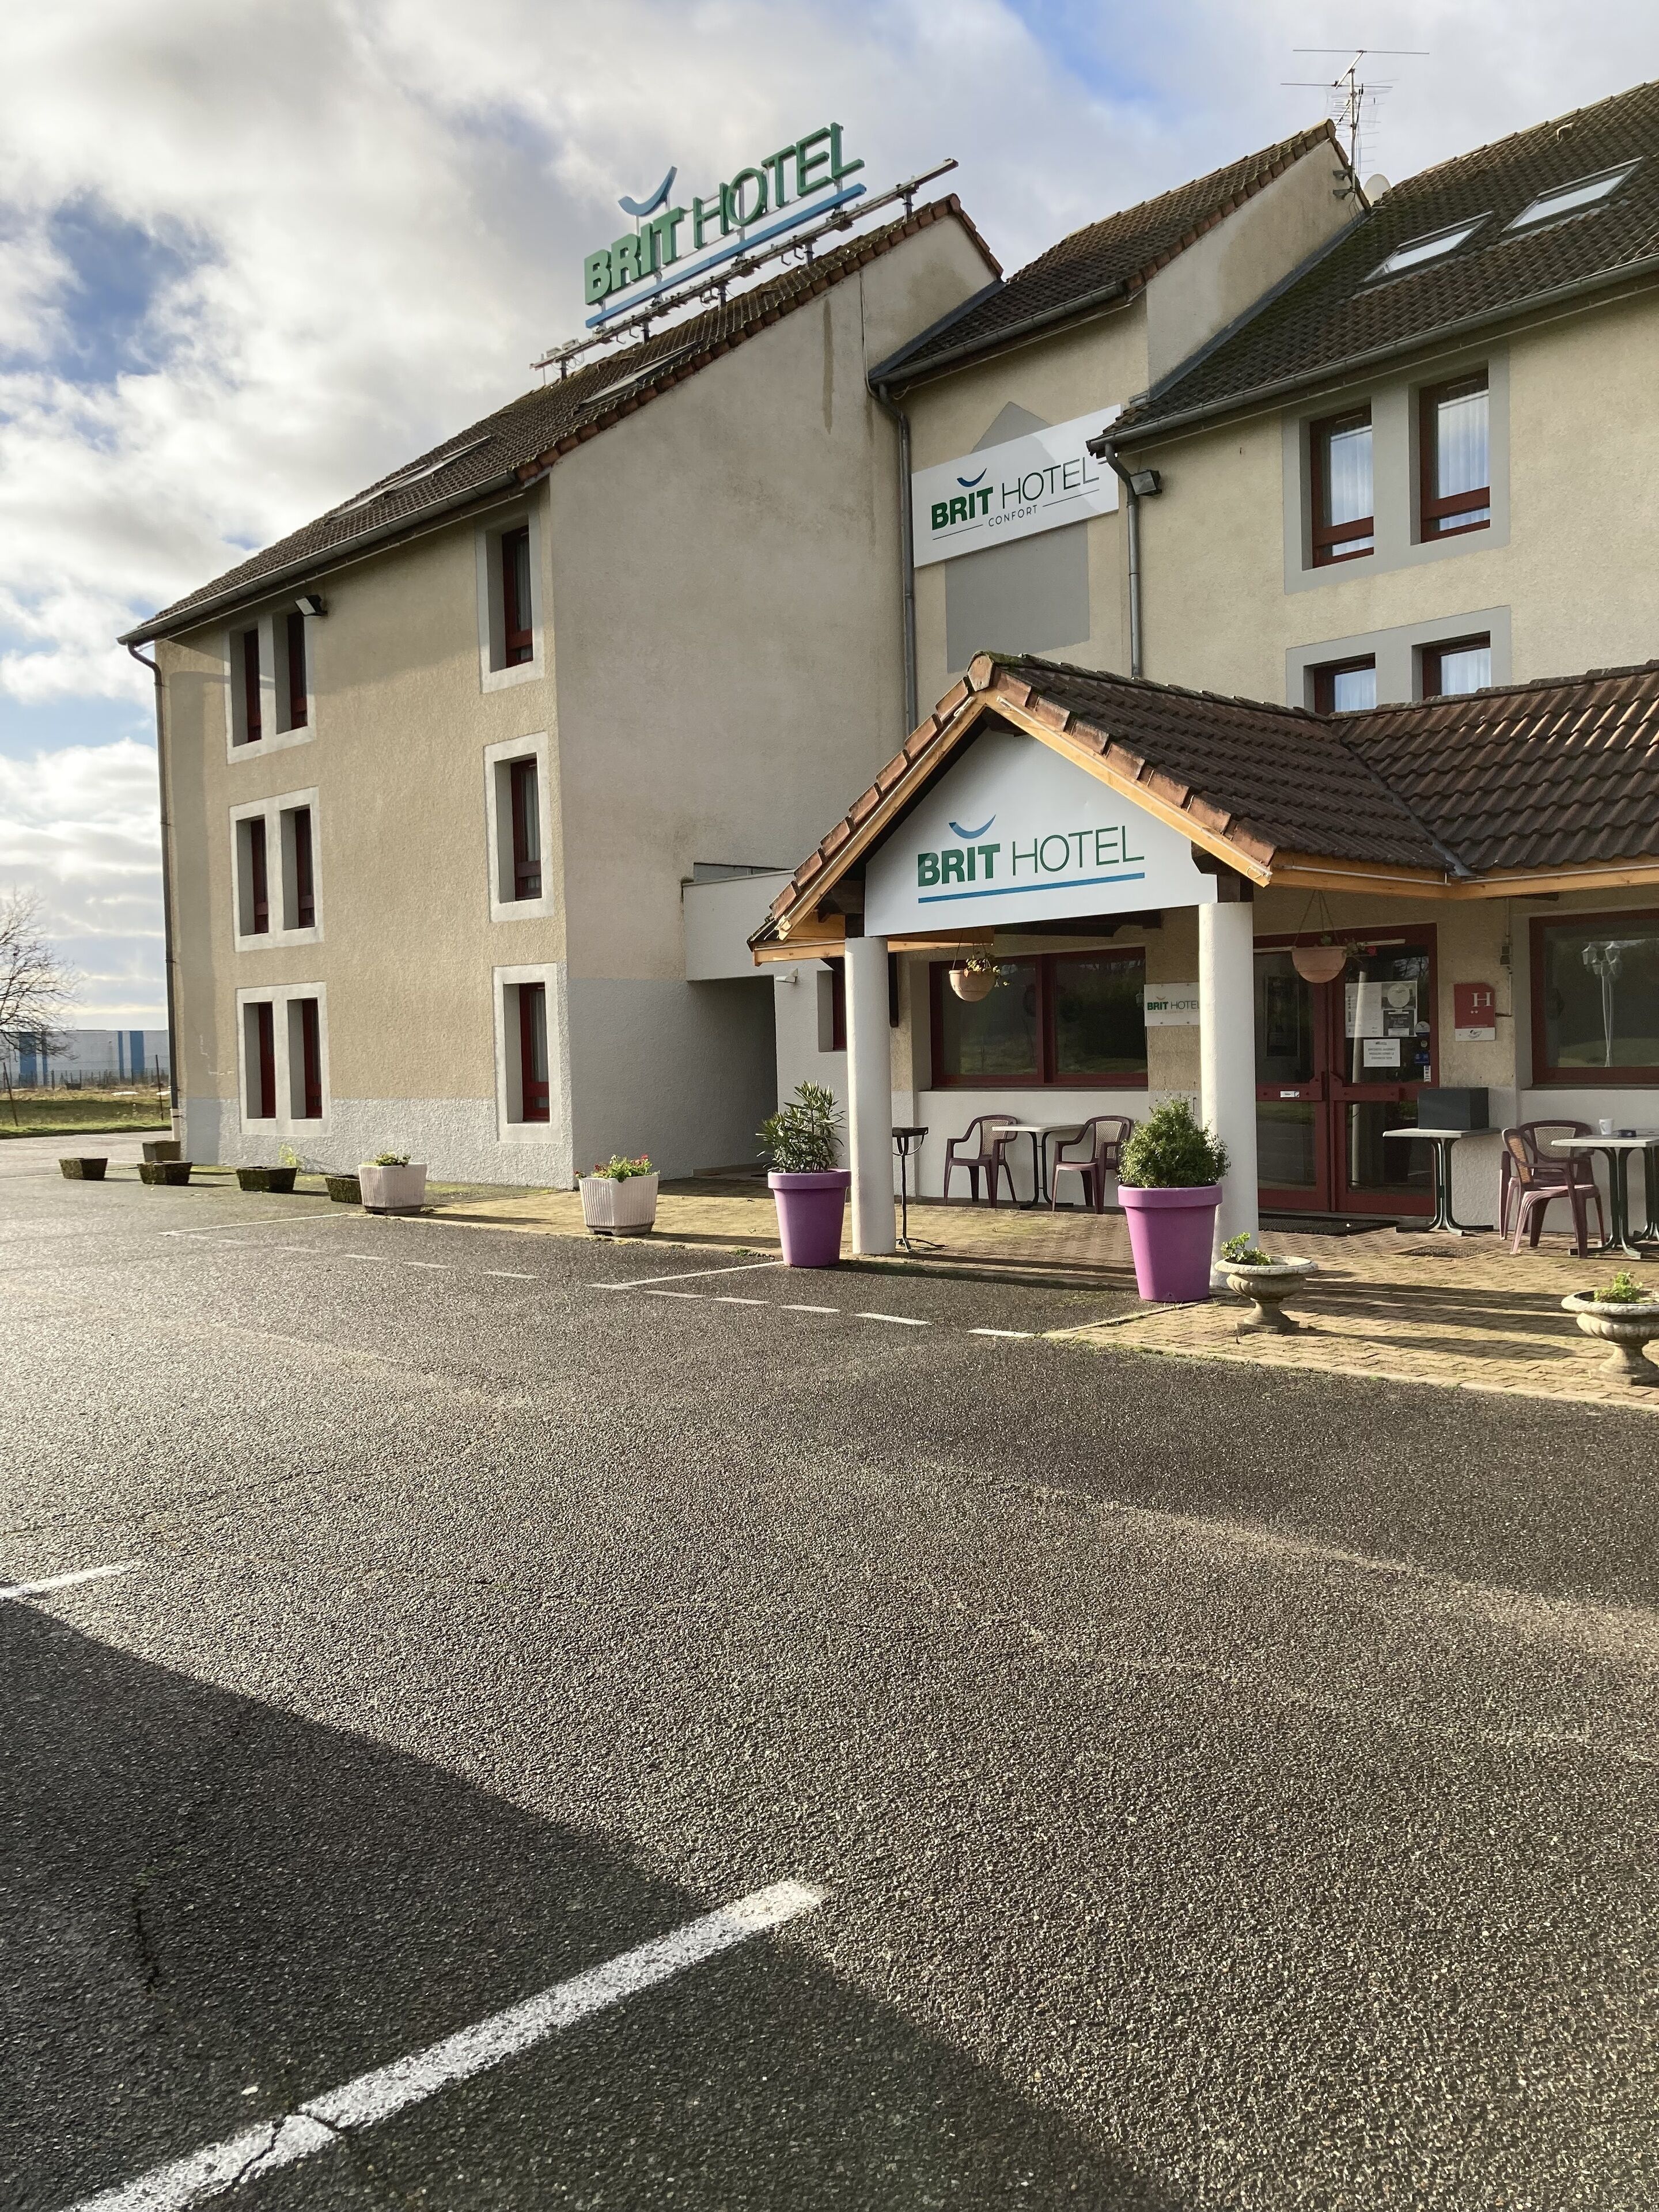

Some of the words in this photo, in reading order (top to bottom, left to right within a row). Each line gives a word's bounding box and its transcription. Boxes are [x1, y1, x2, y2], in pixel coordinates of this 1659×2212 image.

[584, 206, 687, 306] BRIT
[692, 122, 865, 249] HOTEL
[931, 486, 994, 531] BRIT
[1002, 457, 1099, 509] HOTEL
[988, 504, 1037, 527] CONFORT
[918, 843, 1001, 887] BRIT
[1012, 825, 1145, 876] HOTEL
[1147, 1001, 1169, 1010] BRIT
[1471, 992, 1493, 1007] H
